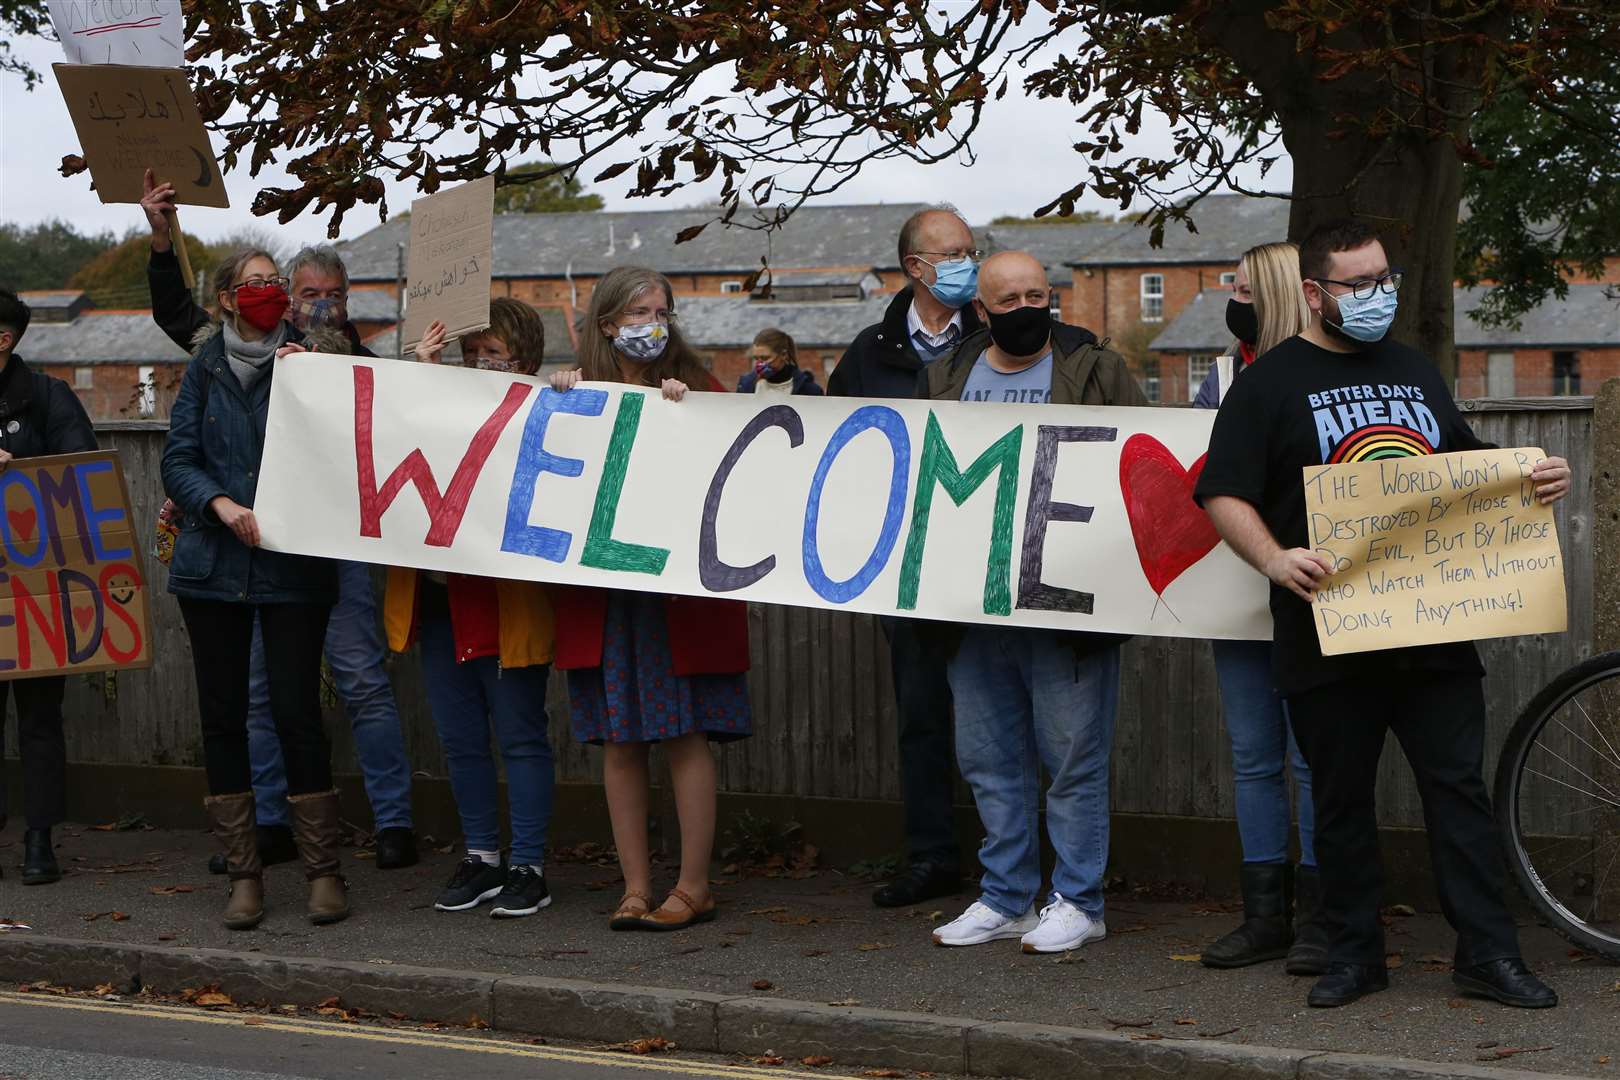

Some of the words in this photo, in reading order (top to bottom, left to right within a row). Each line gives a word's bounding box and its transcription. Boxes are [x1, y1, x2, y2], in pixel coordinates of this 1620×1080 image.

[1308, 385, 1376, 408] BETTER
[1378, 384, 1425, 401] DAYS
[1313, 400, 1441, 464] AHEAD
[353, 364, 1117, 617] WELCOME
[1307, 467, 1359, 504] THE
[1380, 463, 1442, 496] WORLD
[1446, 457, 1501, 490] WON'T
[0, 460, 133, 568] OME
[1312, 508, 1420, 545] DESTROYED
[1427, 496, 1453, 523] BY
[1462, 488, 1509, 516] THOSE
[1367, 537, 1415, 563] EVIL,
[1424, 529, 1466, 556] BUT
[1474, 522, 1497, 548] BY
[1500, 515, 1549, 544] THOSE
[1315, 582, 1355, 604] WHO
[1367, 571, 1424, 596] WATCH
[1433, 560, 1476, 586] THEM
[1482, 553, 1557, 578] WITHOUT
[1320, 606, 1392, 637] DOING
[1415, 589, 1523, 626] ANYTHING!
